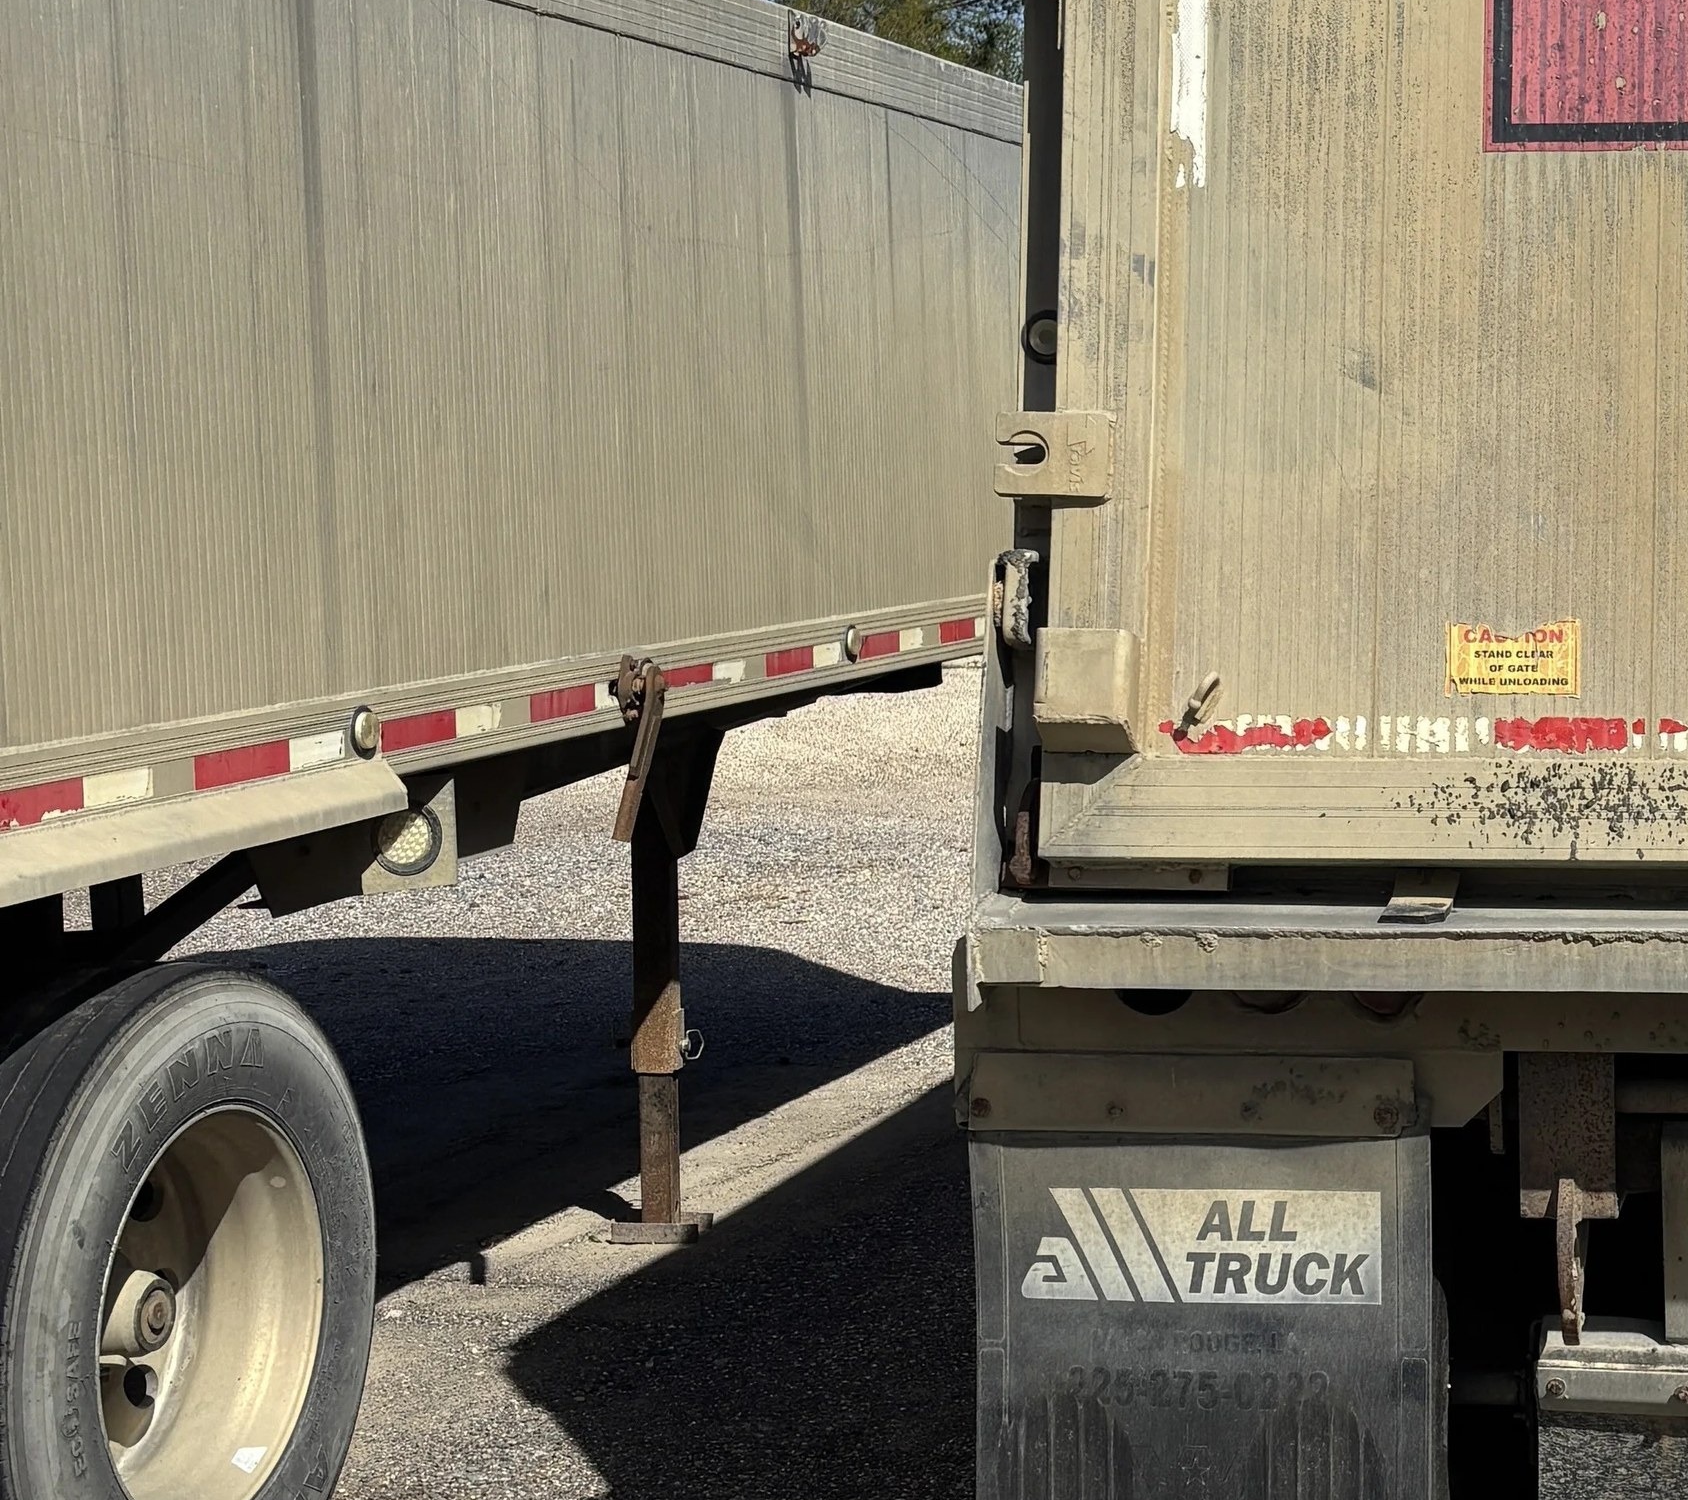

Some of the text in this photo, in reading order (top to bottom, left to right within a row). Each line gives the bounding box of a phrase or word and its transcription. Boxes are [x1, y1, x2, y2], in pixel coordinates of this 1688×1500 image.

[1463, 629, 1564, 644] CAION
[1474, 650, 1554, 659] STAND CLEAR
[1489, 664, 1538, 673] OF GATE
[1458, 677, 1569, 686] WHILE UNLOADING
[1196, 1200, 1298, 1242] ALL
[1185, 1252, 1371, 1296] TRUCK
